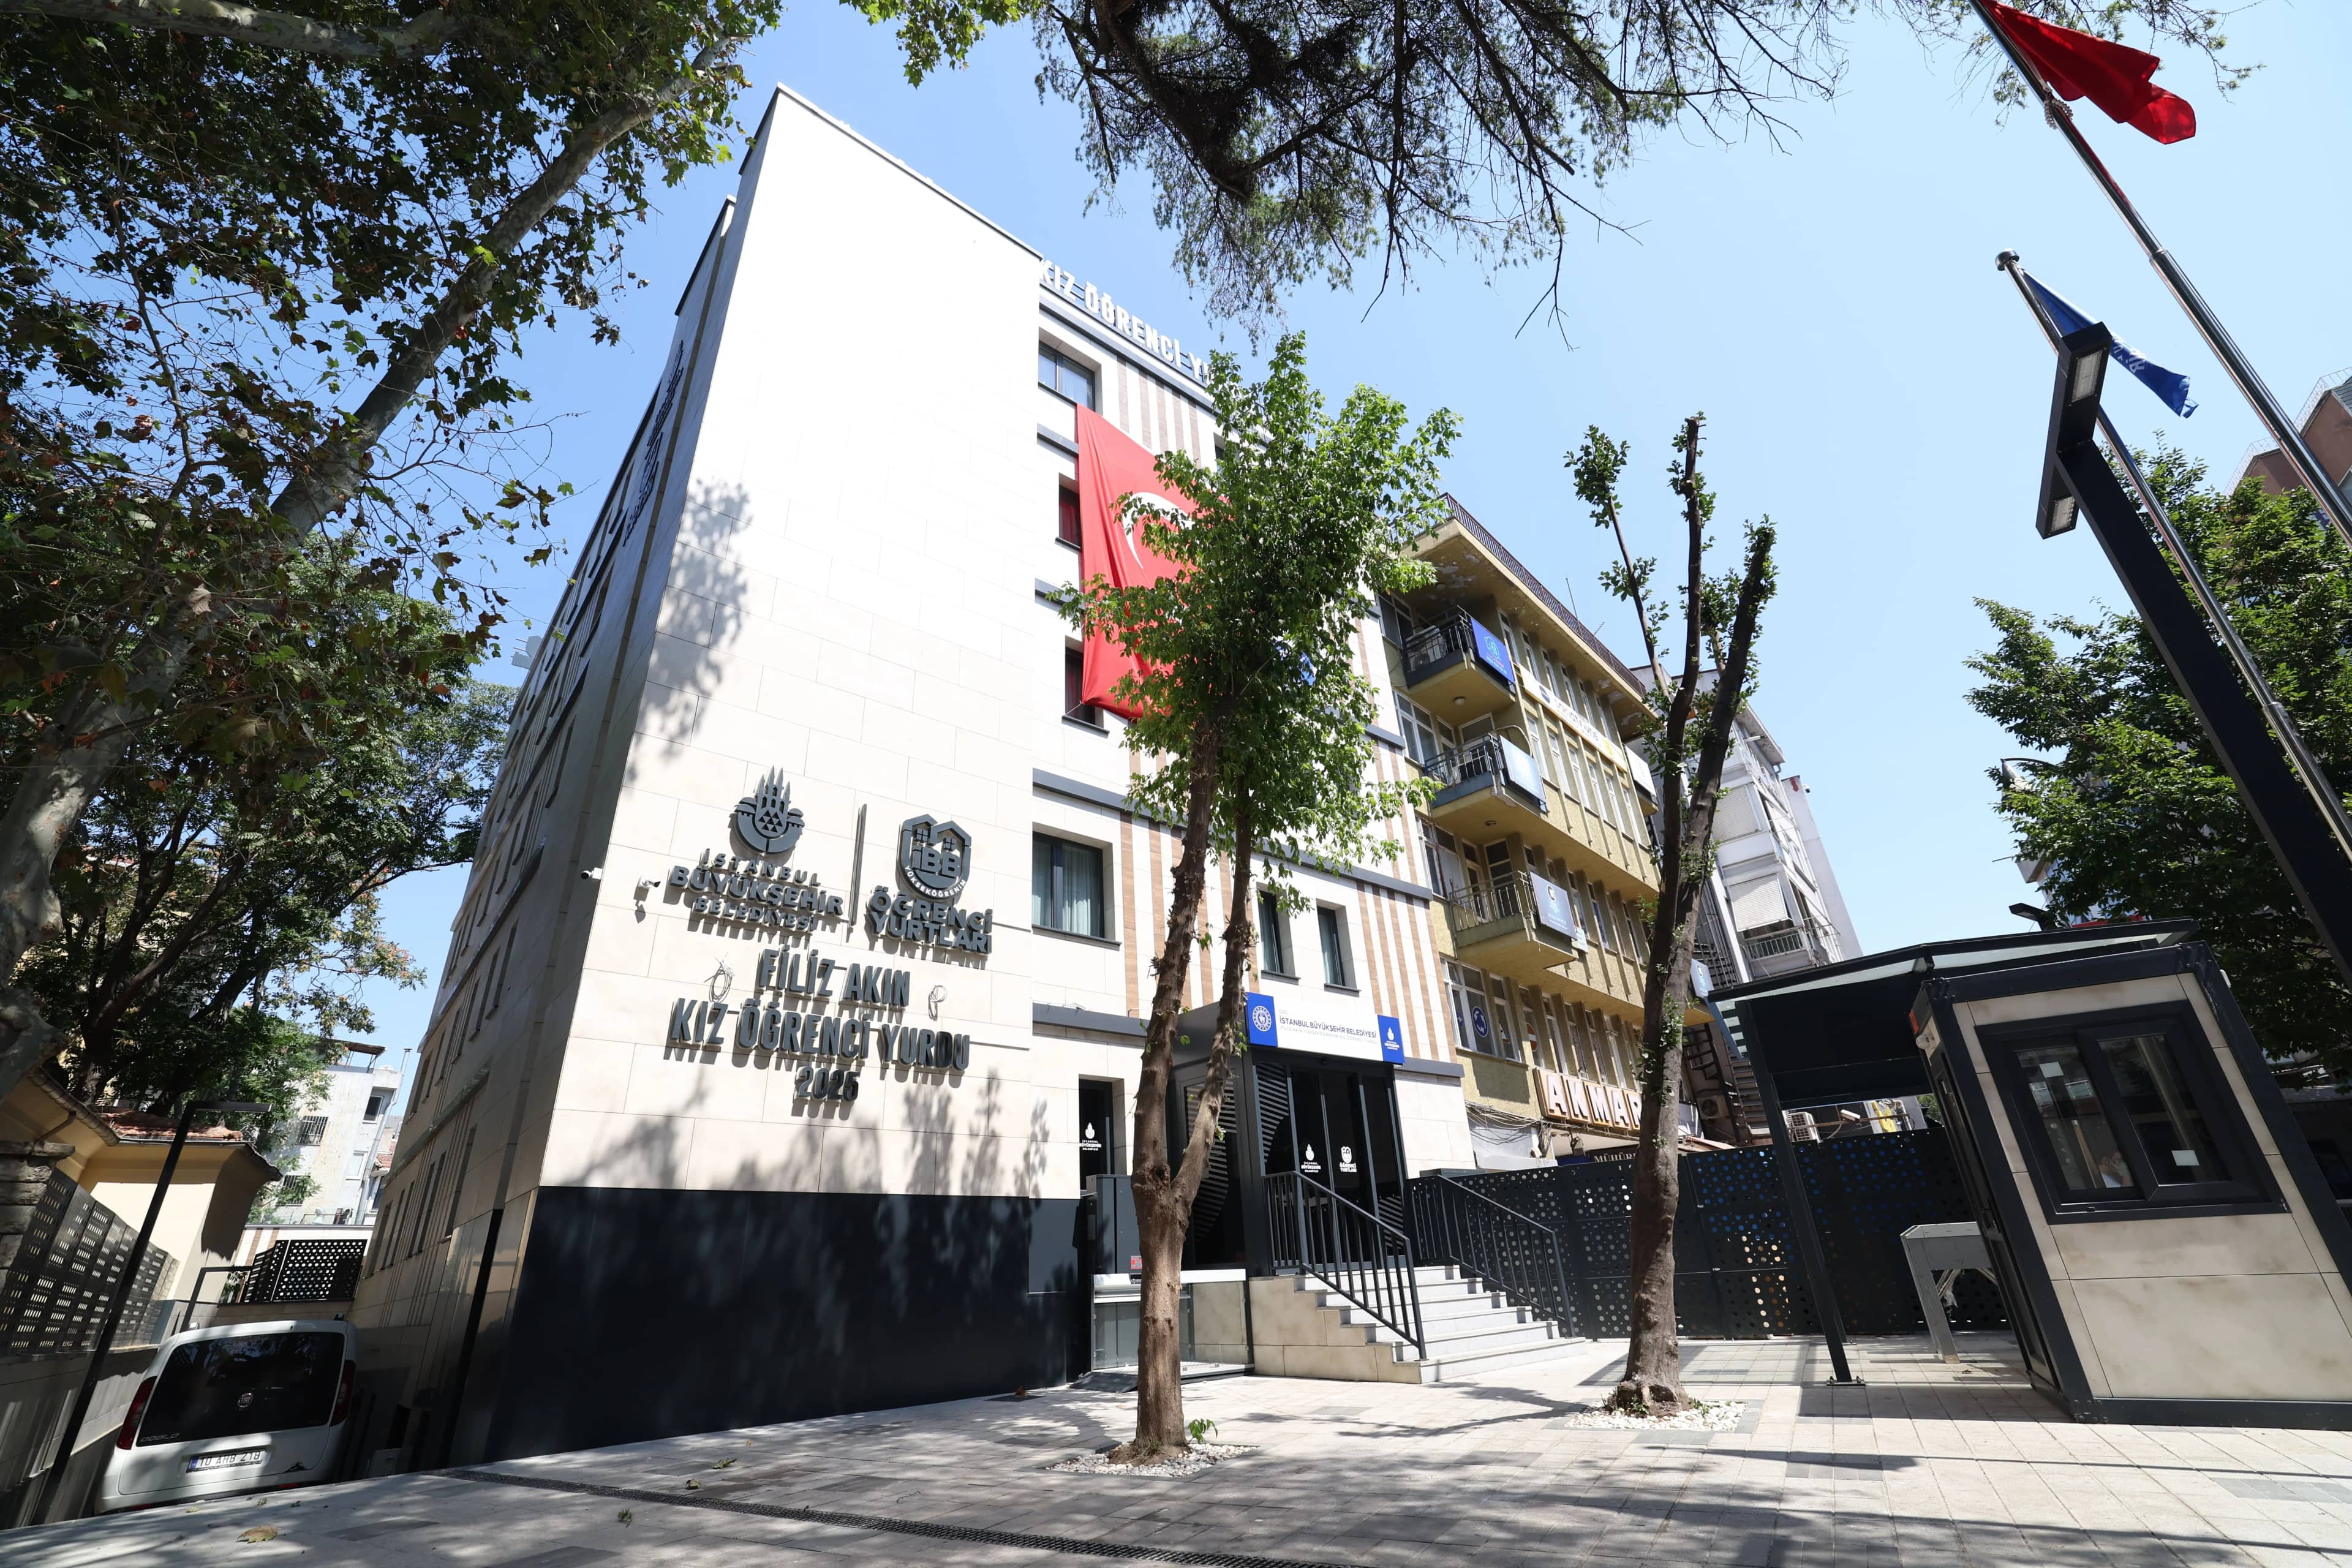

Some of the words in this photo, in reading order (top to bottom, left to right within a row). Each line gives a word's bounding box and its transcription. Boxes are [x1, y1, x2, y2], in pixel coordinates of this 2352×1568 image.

[669, 865, 843, 916] BÜYÜKŞEHİR
[703, 848, 821, 887] İSTANBUL
[869, 885, 993, 934] ÖĞRENCİ
[870, 911, 992, 954] YURTLARI
[758, 944, 835, 997] FİLİZ
[843, 963, 910, 1007] AKIN
[670, 998, 729, 1045] KIZ
[738, 998, 871, 1059] ÖĞRENCİ
[881, 1023, 970, 1071] YURDU
[1280, 1015, 1310, 1028] İSTANBUL
[1310, 1020, 1346, 1033] BÜYÜKŞEHİR
[1346, 1028, 1377, 1038] BELEDİYESİ
[796, 1066, 860, 1102] 2025
[1547, 1074, 1643, 1128] AKMAR
